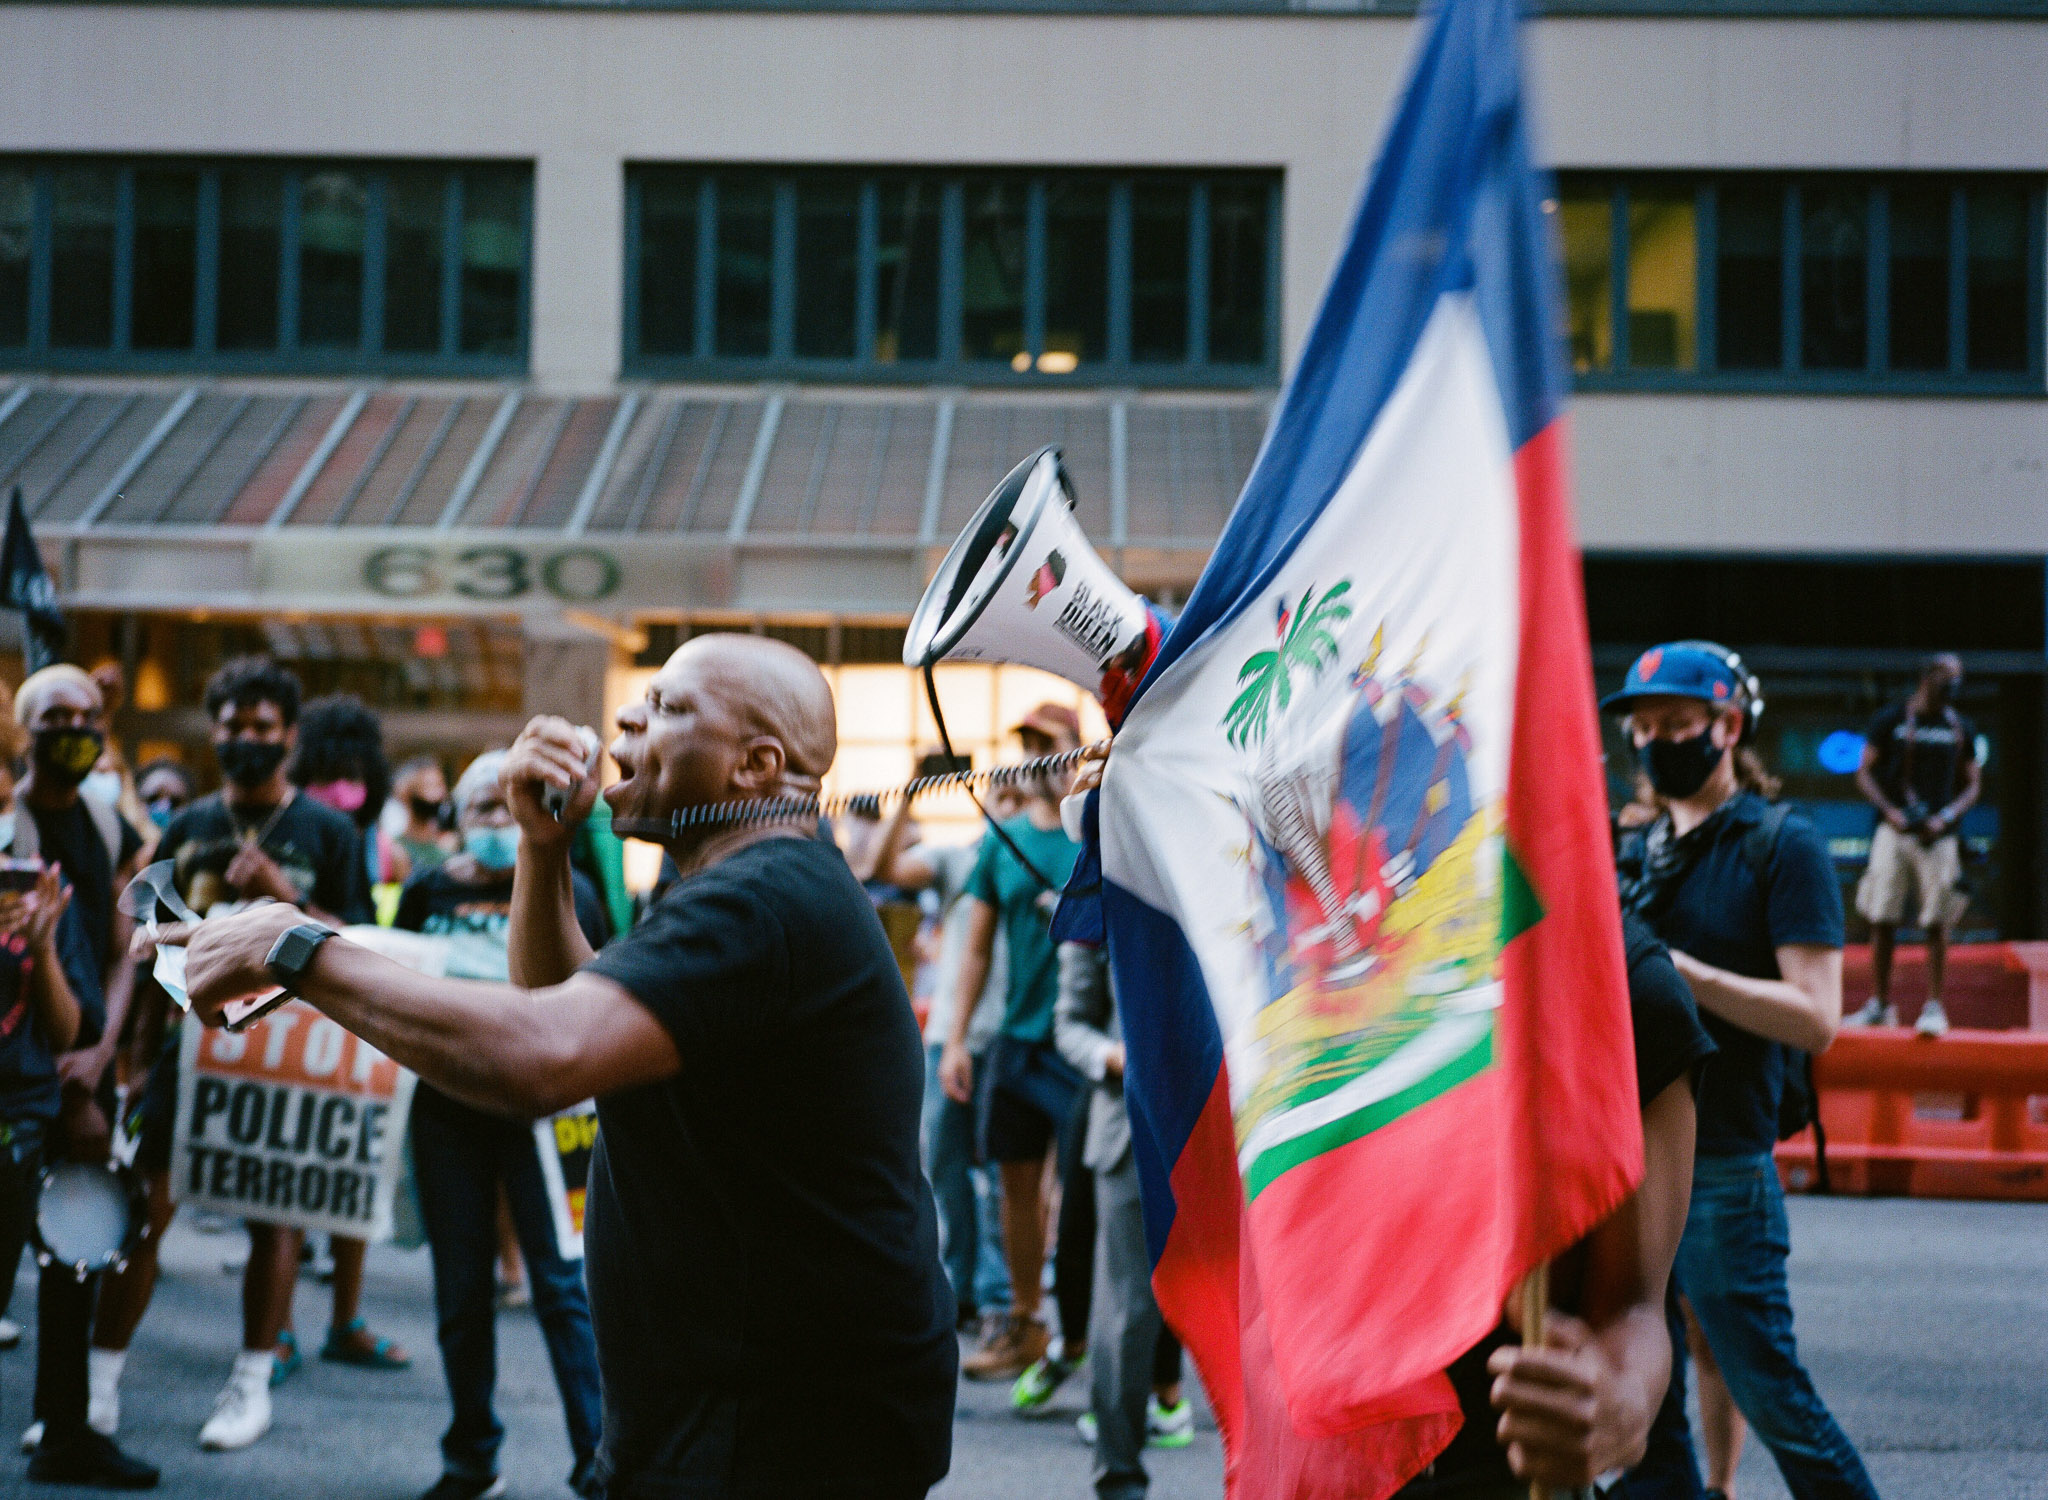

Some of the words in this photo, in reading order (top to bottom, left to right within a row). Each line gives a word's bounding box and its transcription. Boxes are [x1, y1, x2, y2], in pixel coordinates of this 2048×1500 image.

[362, 543, 624, 602] 630
[1060, 602, 1117, 657] QUEEN
[1072, 580, 1123, 640] BLACK
[190, 1077, 388, 1163] POLICE
